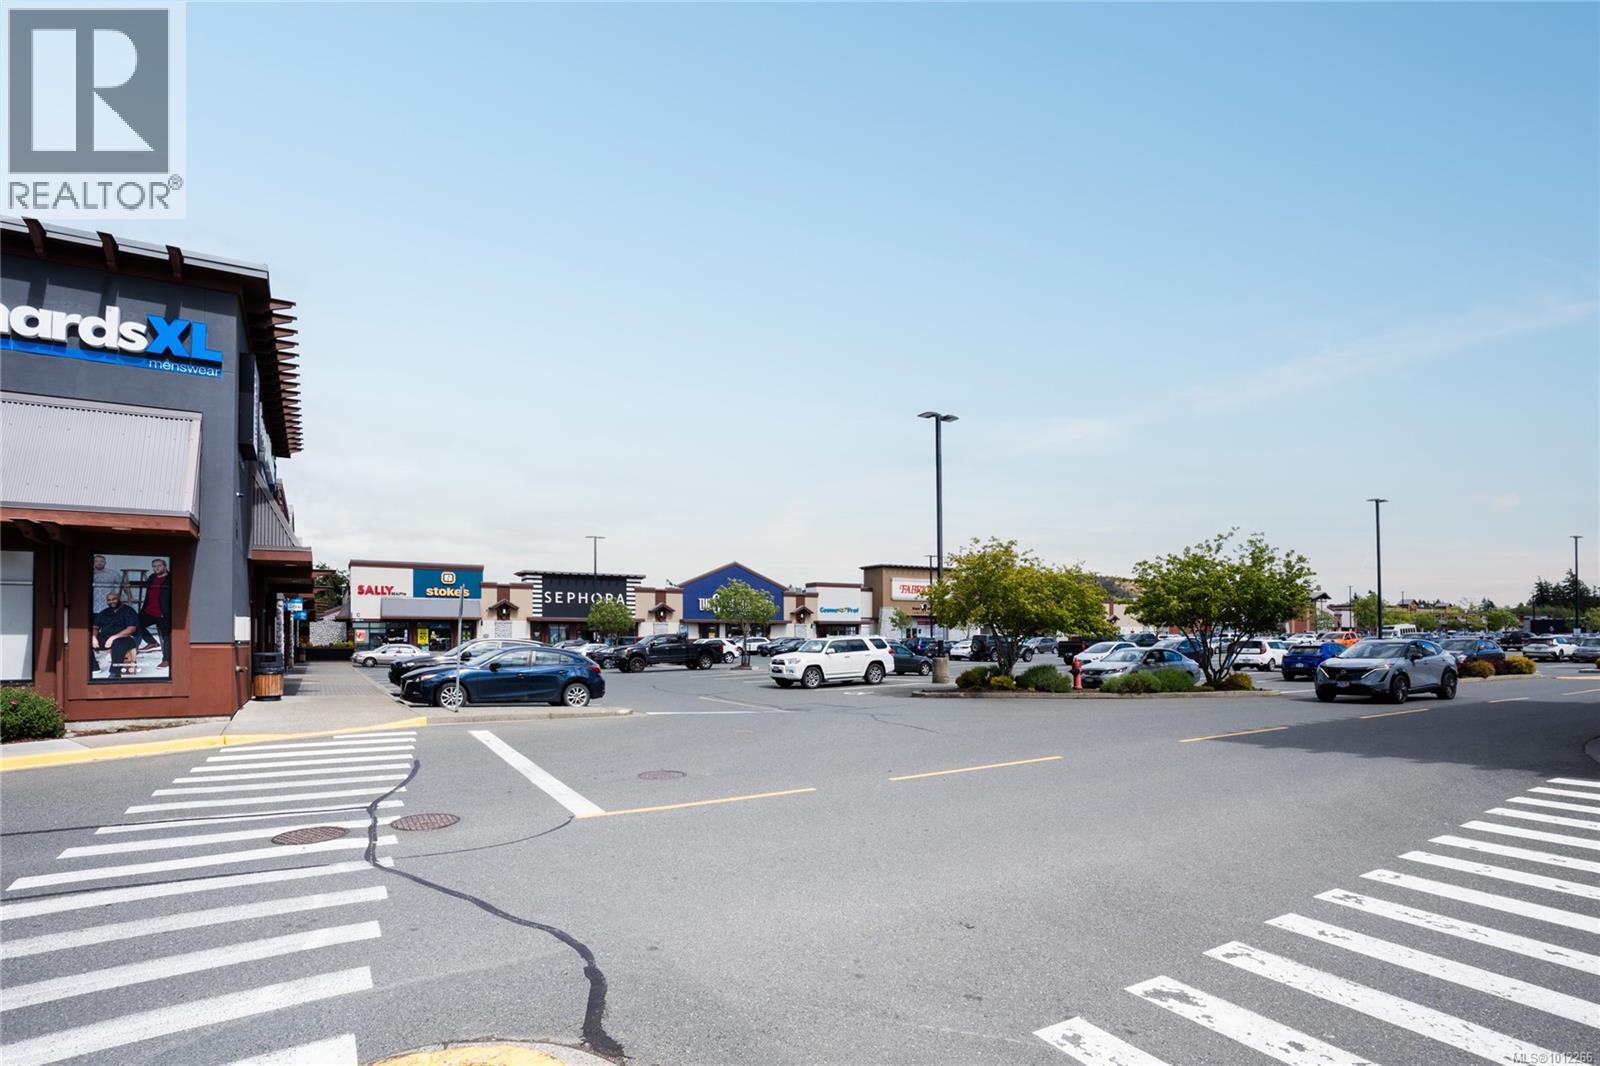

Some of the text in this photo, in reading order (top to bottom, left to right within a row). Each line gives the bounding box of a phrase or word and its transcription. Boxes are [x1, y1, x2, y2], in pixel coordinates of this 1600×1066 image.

[0, 302, 223, 362] ardsXL
[149, 359, 221, 377] menswear
[357, 585, 393, 595] SALLY
[426, 587, 470, 597] stokes
[544, 591, 626, 604] SEPHORA
